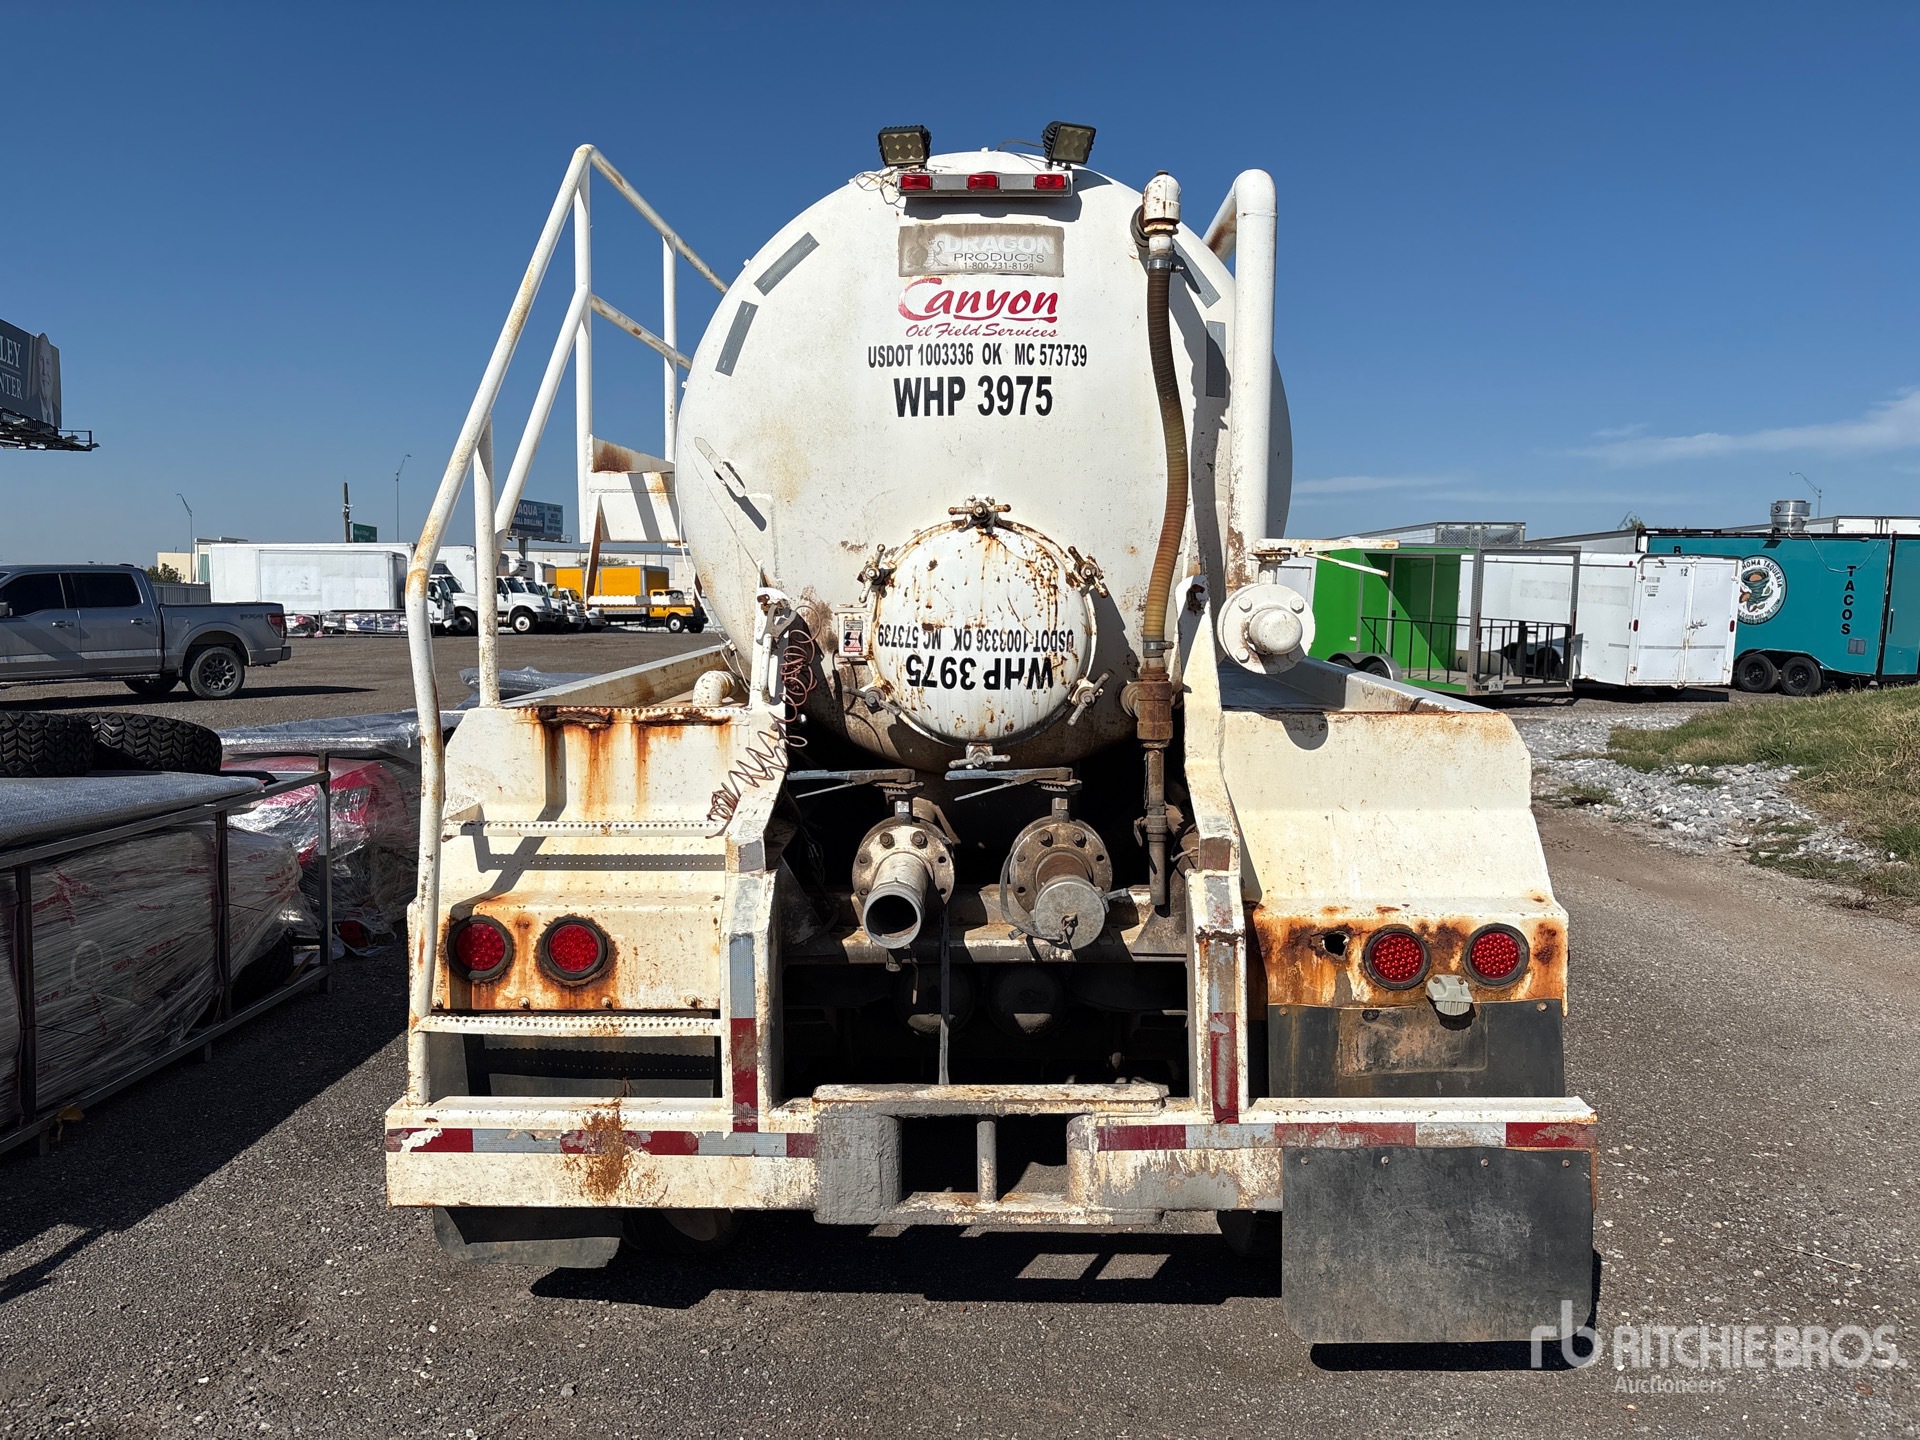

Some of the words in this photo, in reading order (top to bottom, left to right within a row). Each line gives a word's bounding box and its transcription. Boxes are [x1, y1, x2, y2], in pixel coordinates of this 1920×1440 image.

[944, 235, 1055, 254] DRAGON
[954, 253, 1045, 263] PRODUCTS
[964, 262, 1035, 271] 1-800-231-8198
[898, 277, 1059, 324] Canyon
[906, 324, 932, 338] Oil
[934, 322, 981, 339] Field
[982, 322, 1059, 338] Services
[868, 344, 914, 368] USDOT
[918, 343, 974, 366] 1003336
[982, 343, 1003, 365] OK
[1015, 343, 1036, 366] MC
[1039, 344, 1088, 367] 573739
[893, 376, 966, 417] WHP
[977, 375, 1053, 416] 3975
[1841, 565, 1856, 635] TACOS
[878, 624, 919, 650] 573739
[923, 627, 942, 650] MC
[953, 628, 972, 652] OK
[976, 628, 1028, 653] 1003336
[1032, 629, 1074, 653] USDOT
[905, 654, 977, 691] 3975
[983, 657, 1054, 691] WHP
